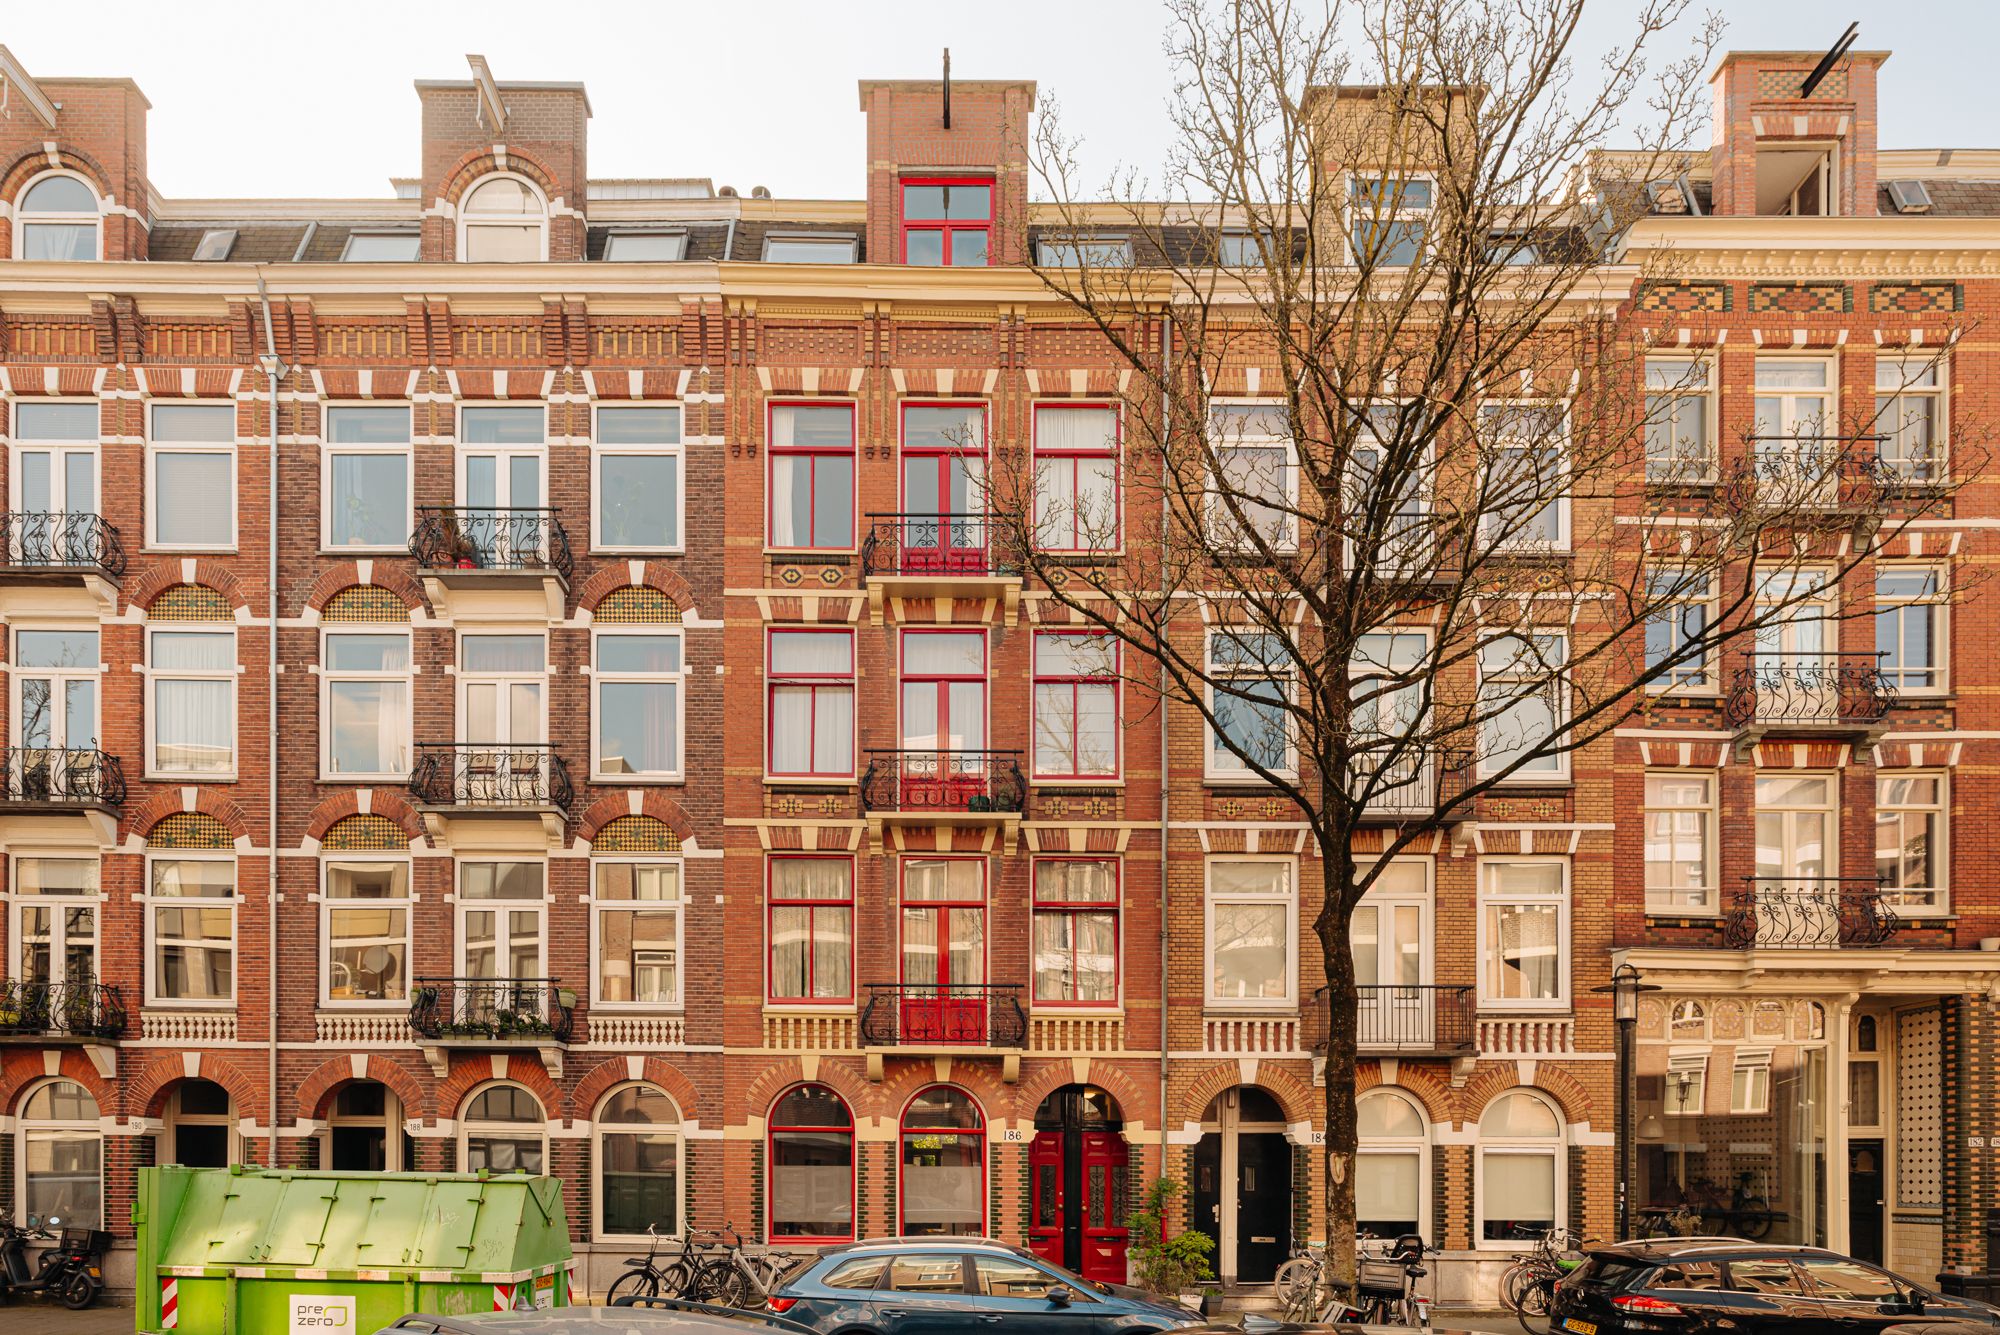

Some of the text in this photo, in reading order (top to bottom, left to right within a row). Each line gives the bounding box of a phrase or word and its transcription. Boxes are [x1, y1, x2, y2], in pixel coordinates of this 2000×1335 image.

[410, 1123, 421, 1131] 188
[1004, 1130, 1022, 1141] 186
[1969, 1138, 1983, 1146] 182
[297, 1305, 323, 1316] pre
[297, 1317, 333, 1326] zero
